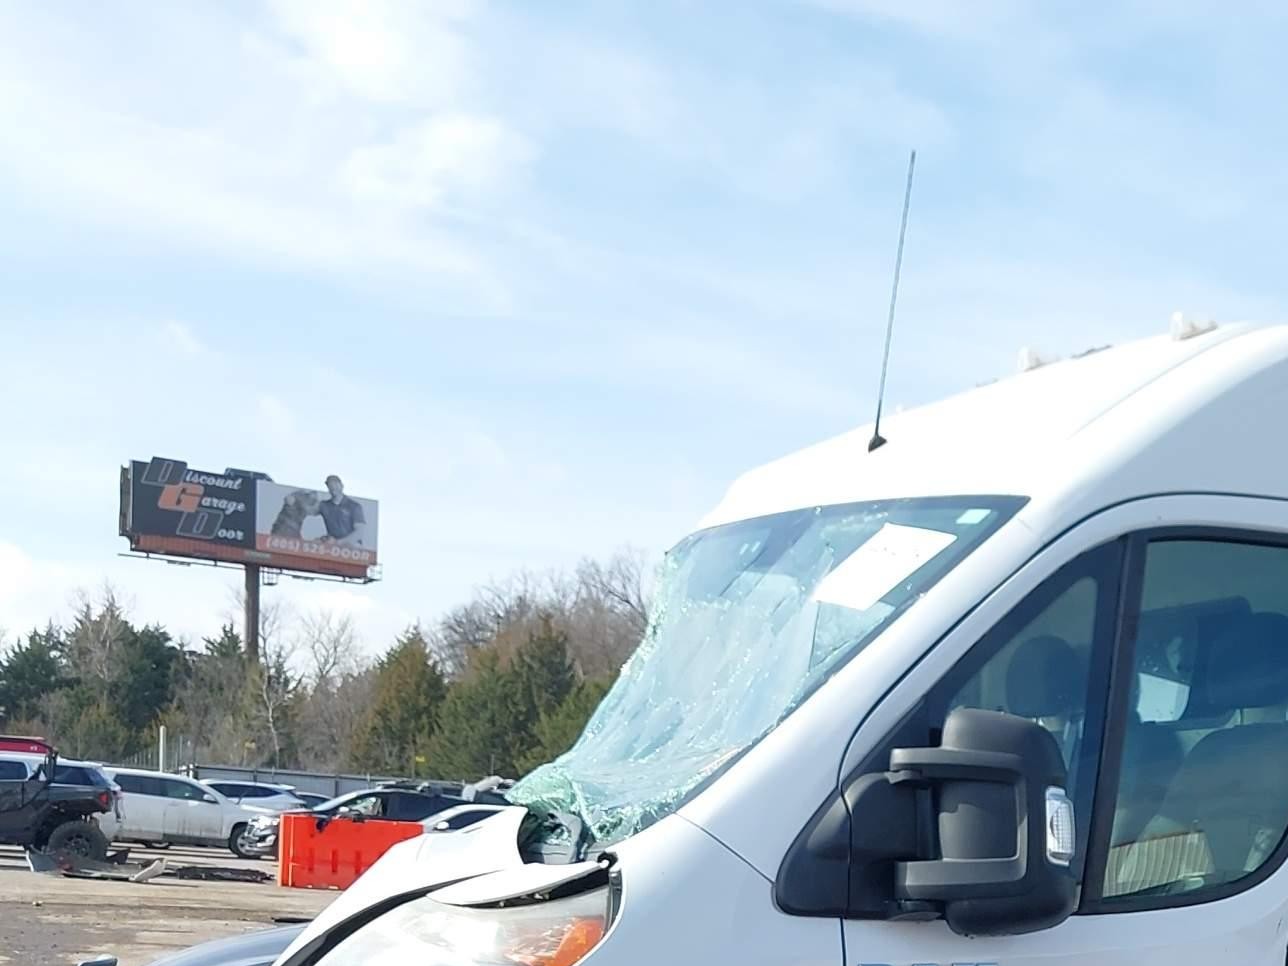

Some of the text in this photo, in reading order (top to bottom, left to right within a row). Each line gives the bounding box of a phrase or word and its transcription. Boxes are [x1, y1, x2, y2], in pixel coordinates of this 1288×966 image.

[141, 456, 243, 489] Discount
[157, 481, 246, 515] Garage
[176, 507, 244, 539] Door
